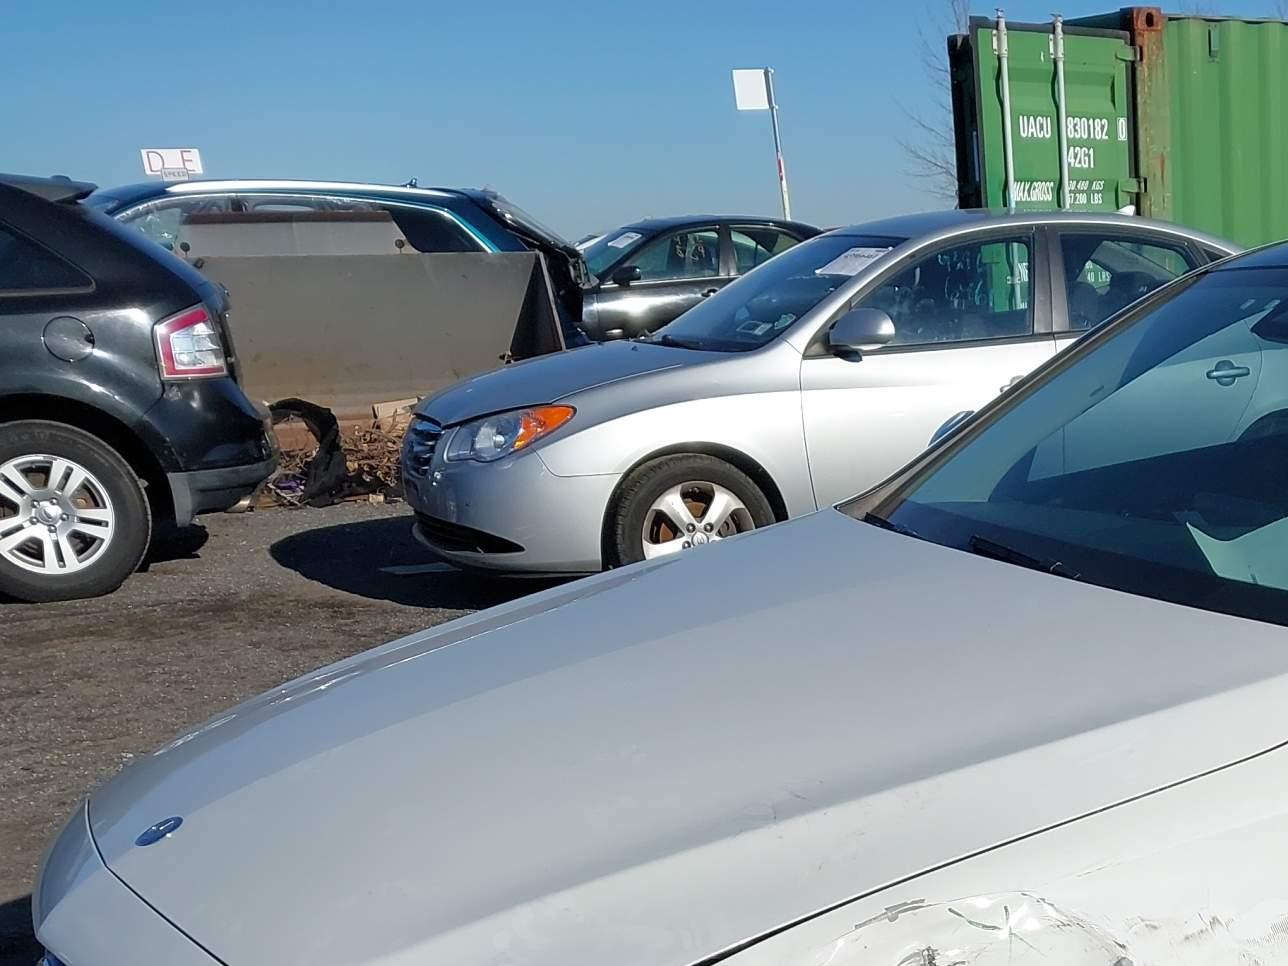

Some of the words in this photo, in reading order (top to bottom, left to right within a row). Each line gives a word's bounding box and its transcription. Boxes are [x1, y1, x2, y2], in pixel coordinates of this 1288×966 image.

[1019, 116, 1051, 138] UACU
[1067, 117, 1109, 140] 830182
[1117, 117, 1128, 140] 0
[1067, 146, 1094, 168] 42G1
[1091, 193, 1103, 204] LBS
